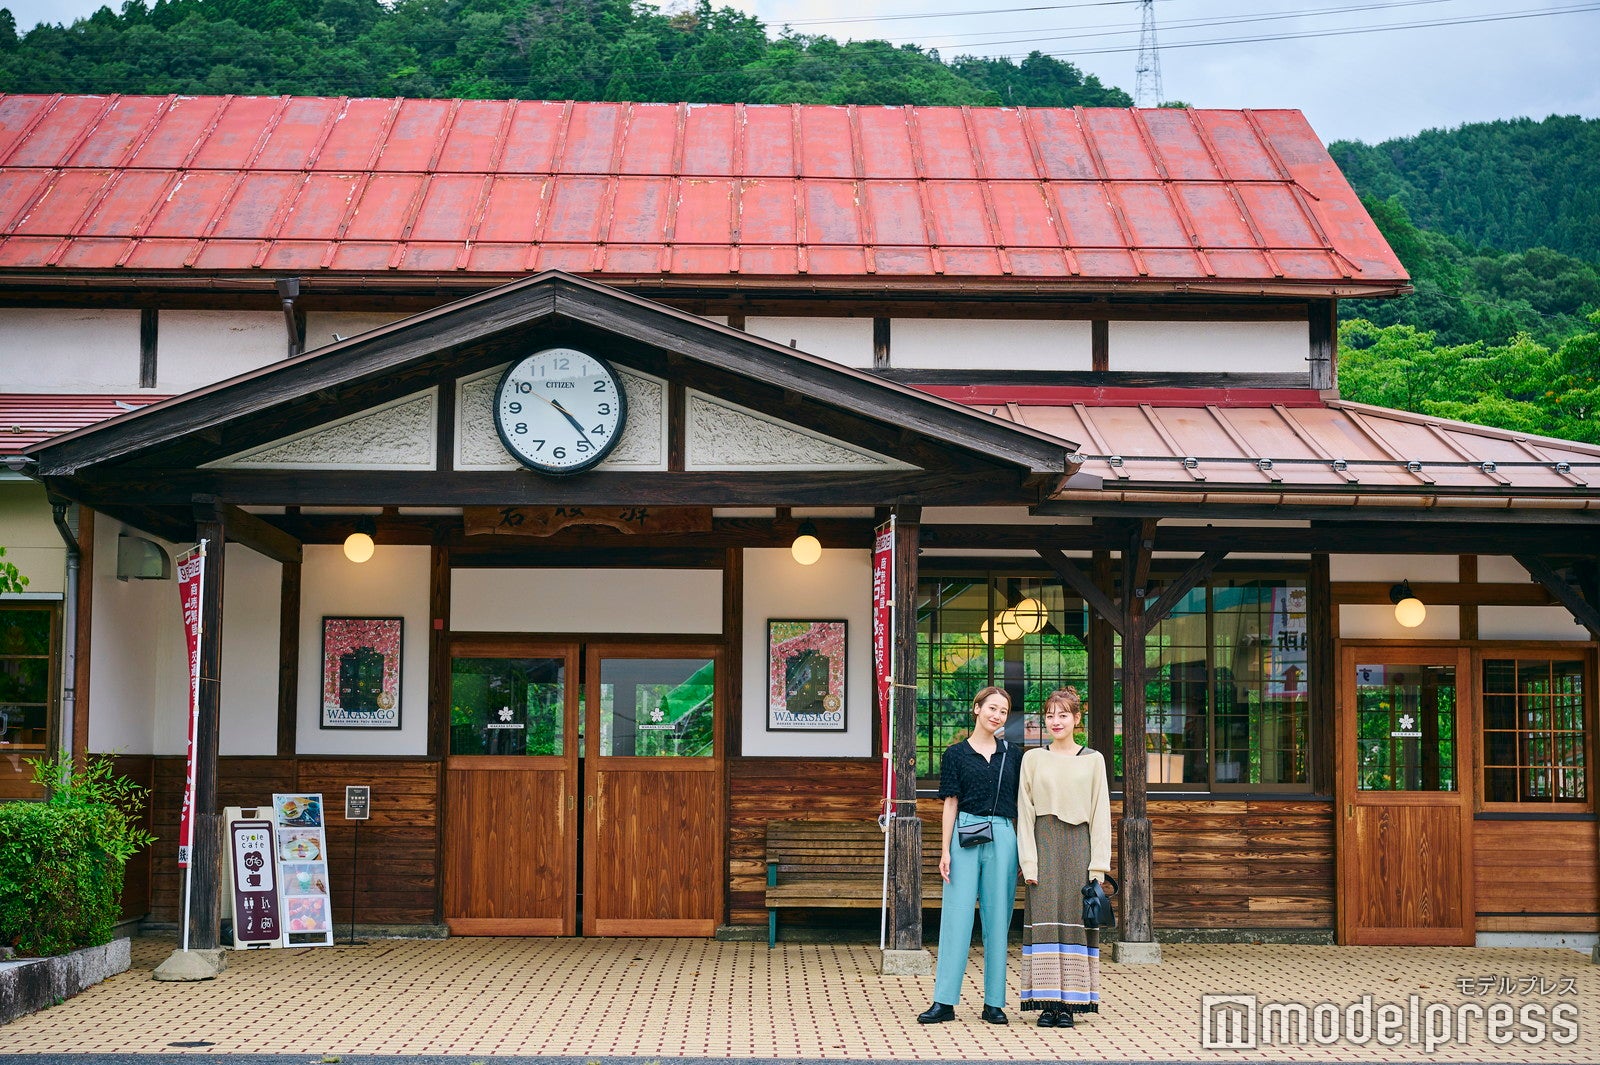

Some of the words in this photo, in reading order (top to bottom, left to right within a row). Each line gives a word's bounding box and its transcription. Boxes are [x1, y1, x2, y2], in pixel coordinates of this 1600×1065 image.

[530, 365, 545, 377] 11
[553, 358, 570, 371] 12
[581, 364, 587, 377] 1
[515, 381, 532, 394] 10
[545, 381, 575, 389] CITIZEN
[593, 380, 606, 393] 2
[508, 401, 522, 414] 9
[597, 403, 611, 416] 3
[514, 422, 528, 435] 8
[591, 423, 606, 436] 4
[532, 439, 546, 452] 7
[576, 440, 589, 453] 5
[552, 446, 566, 459] 6
[327, 709, 395, 720] WAKASAGO
[773, 712, 842, 722] WAKASAGO
[241, 834, 264, 842] cycle
